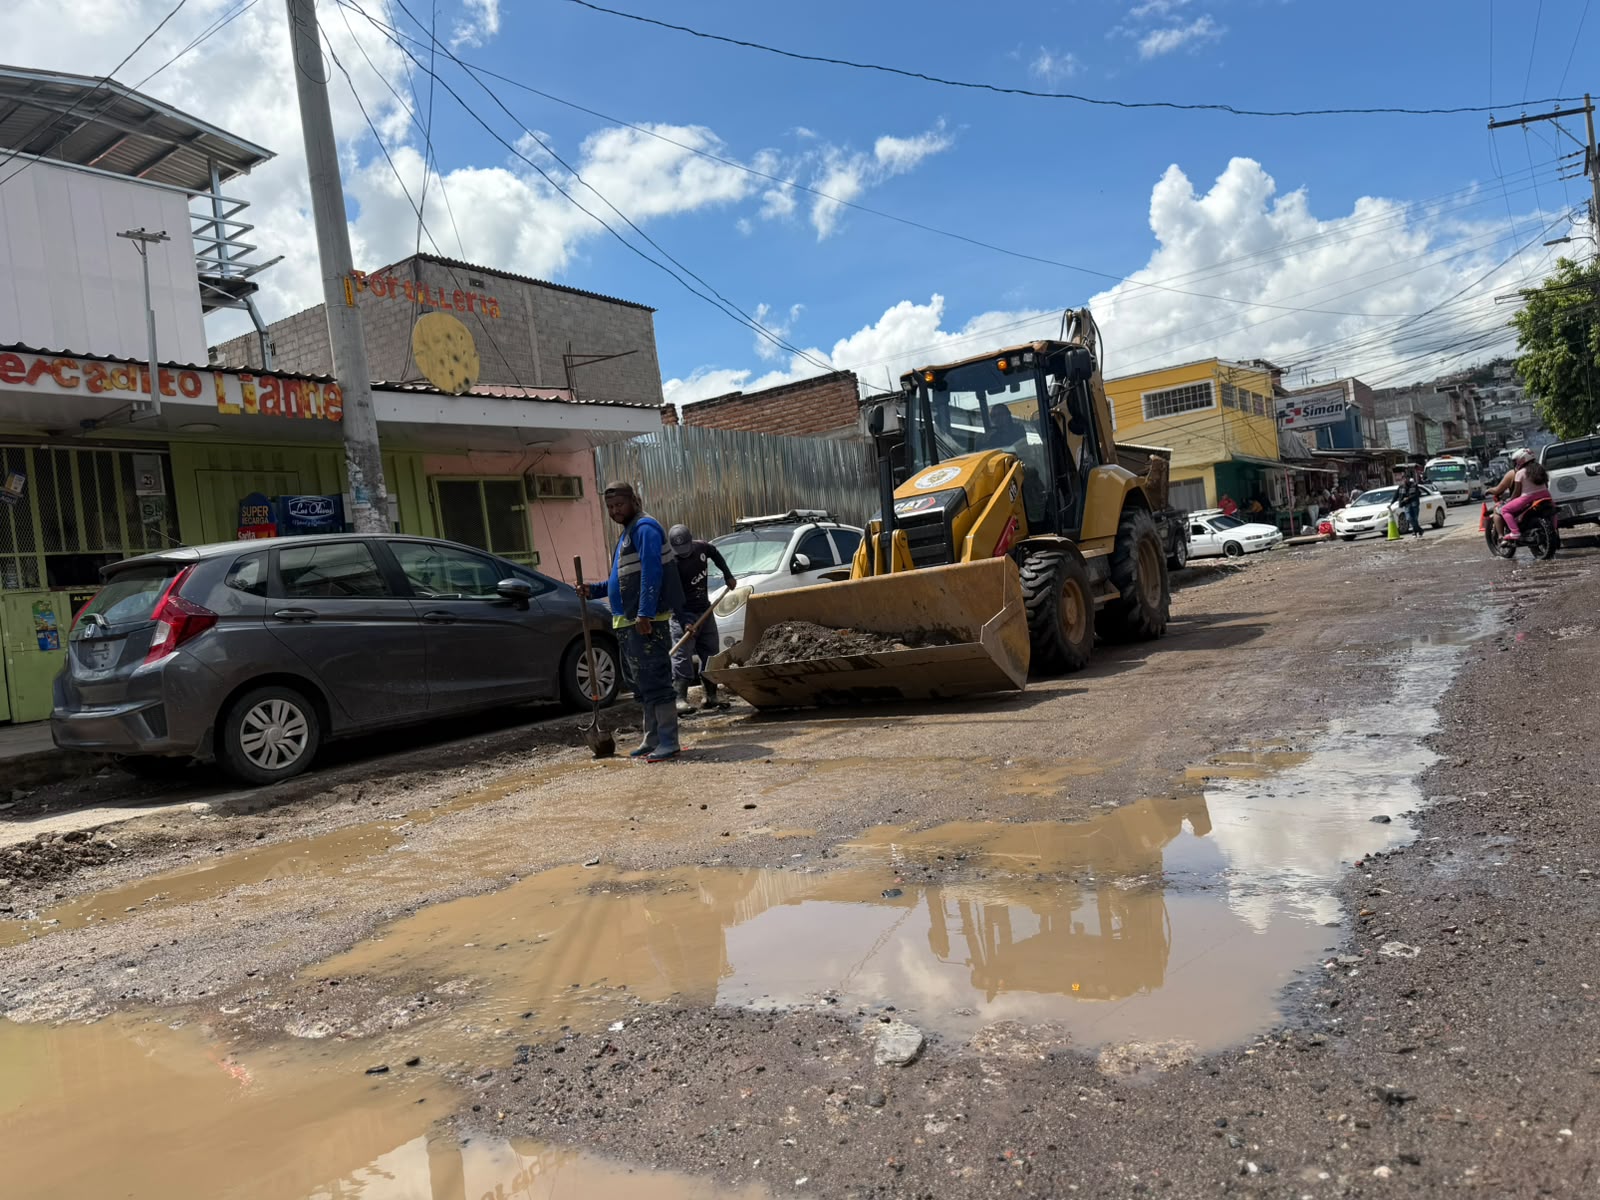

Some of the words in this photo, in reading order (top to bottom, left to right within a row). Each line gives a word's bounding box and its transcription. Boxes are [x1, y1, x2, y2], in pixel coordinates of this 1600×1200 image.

[213, 371, 342, 421] Lianne
[1302, 402, 1343, 417] Simán
[242, 506, 268, 516] SUPER
[895, 498, 928, 513] CAT
